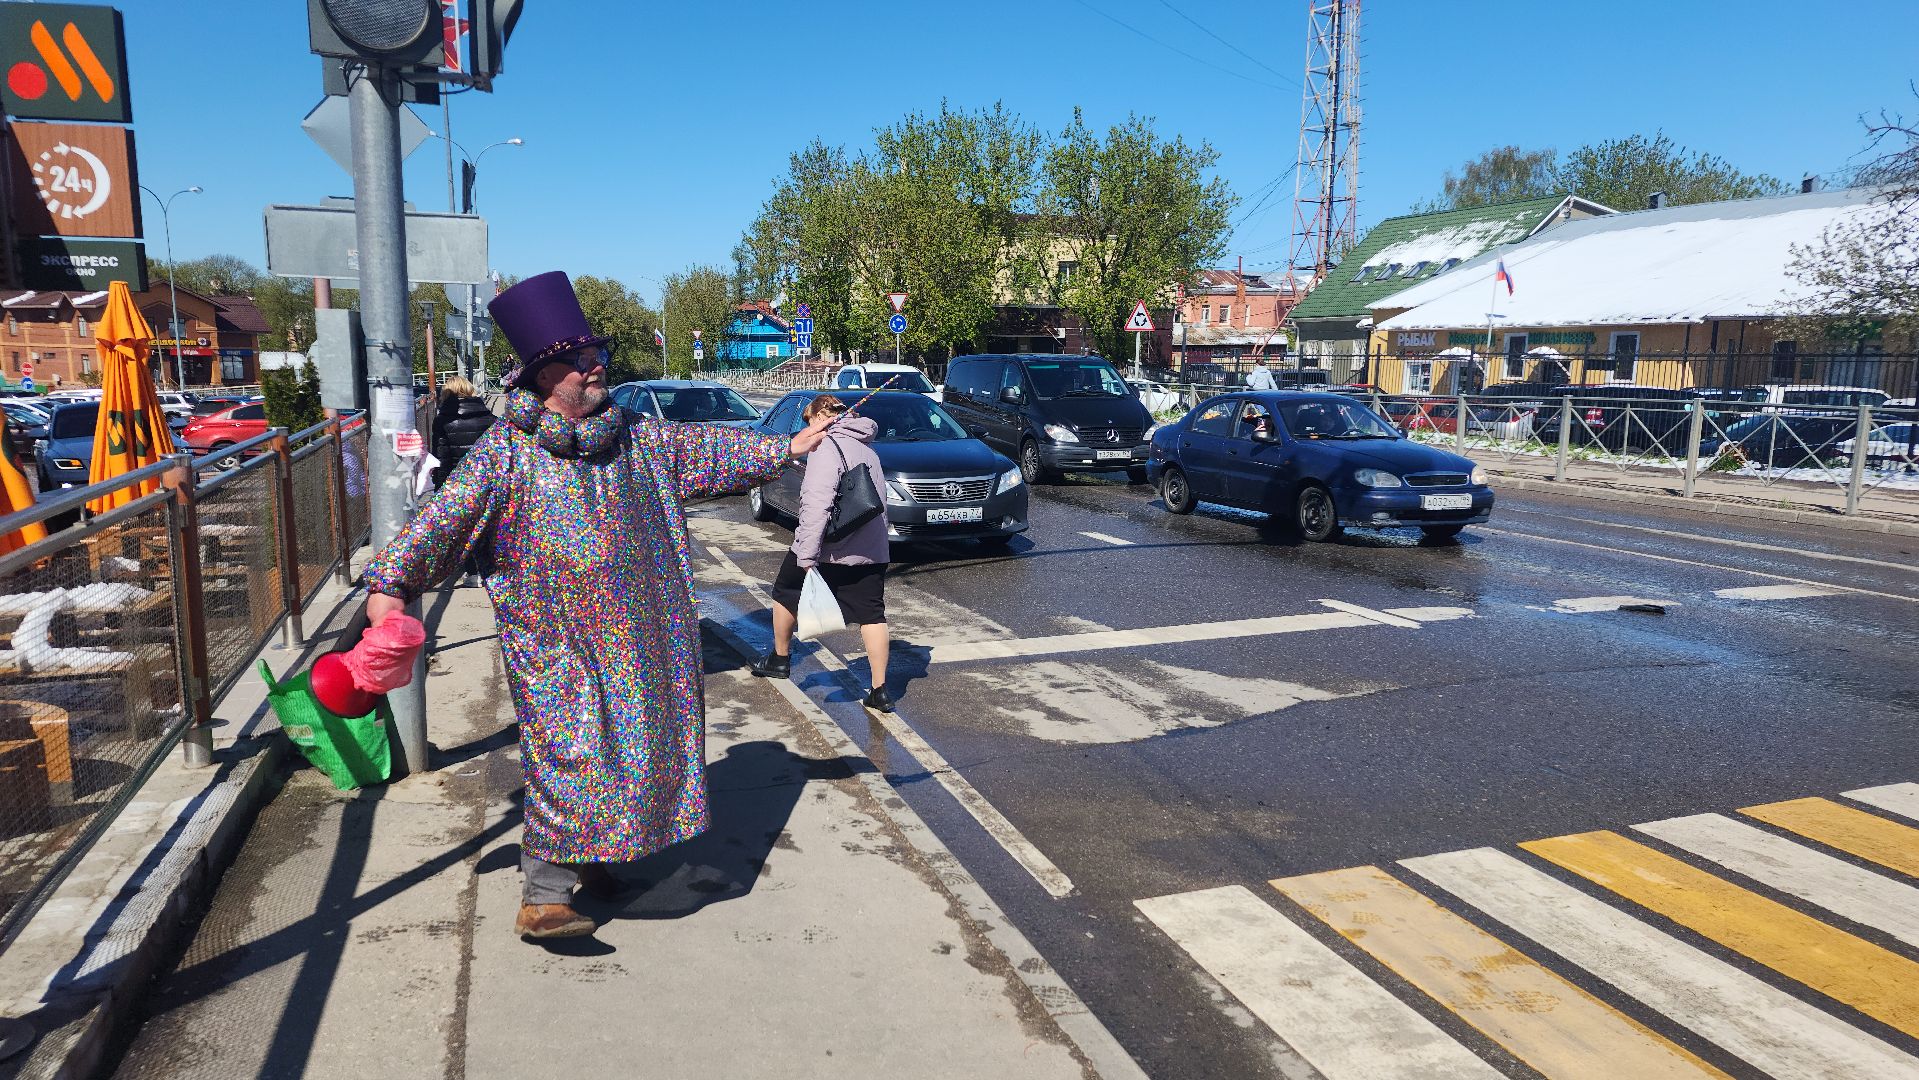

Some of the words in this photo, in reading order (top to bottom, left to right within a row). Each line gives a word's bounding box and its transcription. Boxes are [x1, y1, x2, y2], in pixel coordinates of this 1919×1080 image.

[49, 165, 93, 193] 24ч
[41, 255, 119, 267] ЭКСПРЕСС
[65, 268, 96, 276] ОКНО
[1397, 332, 1437, 347] РЫБАК
